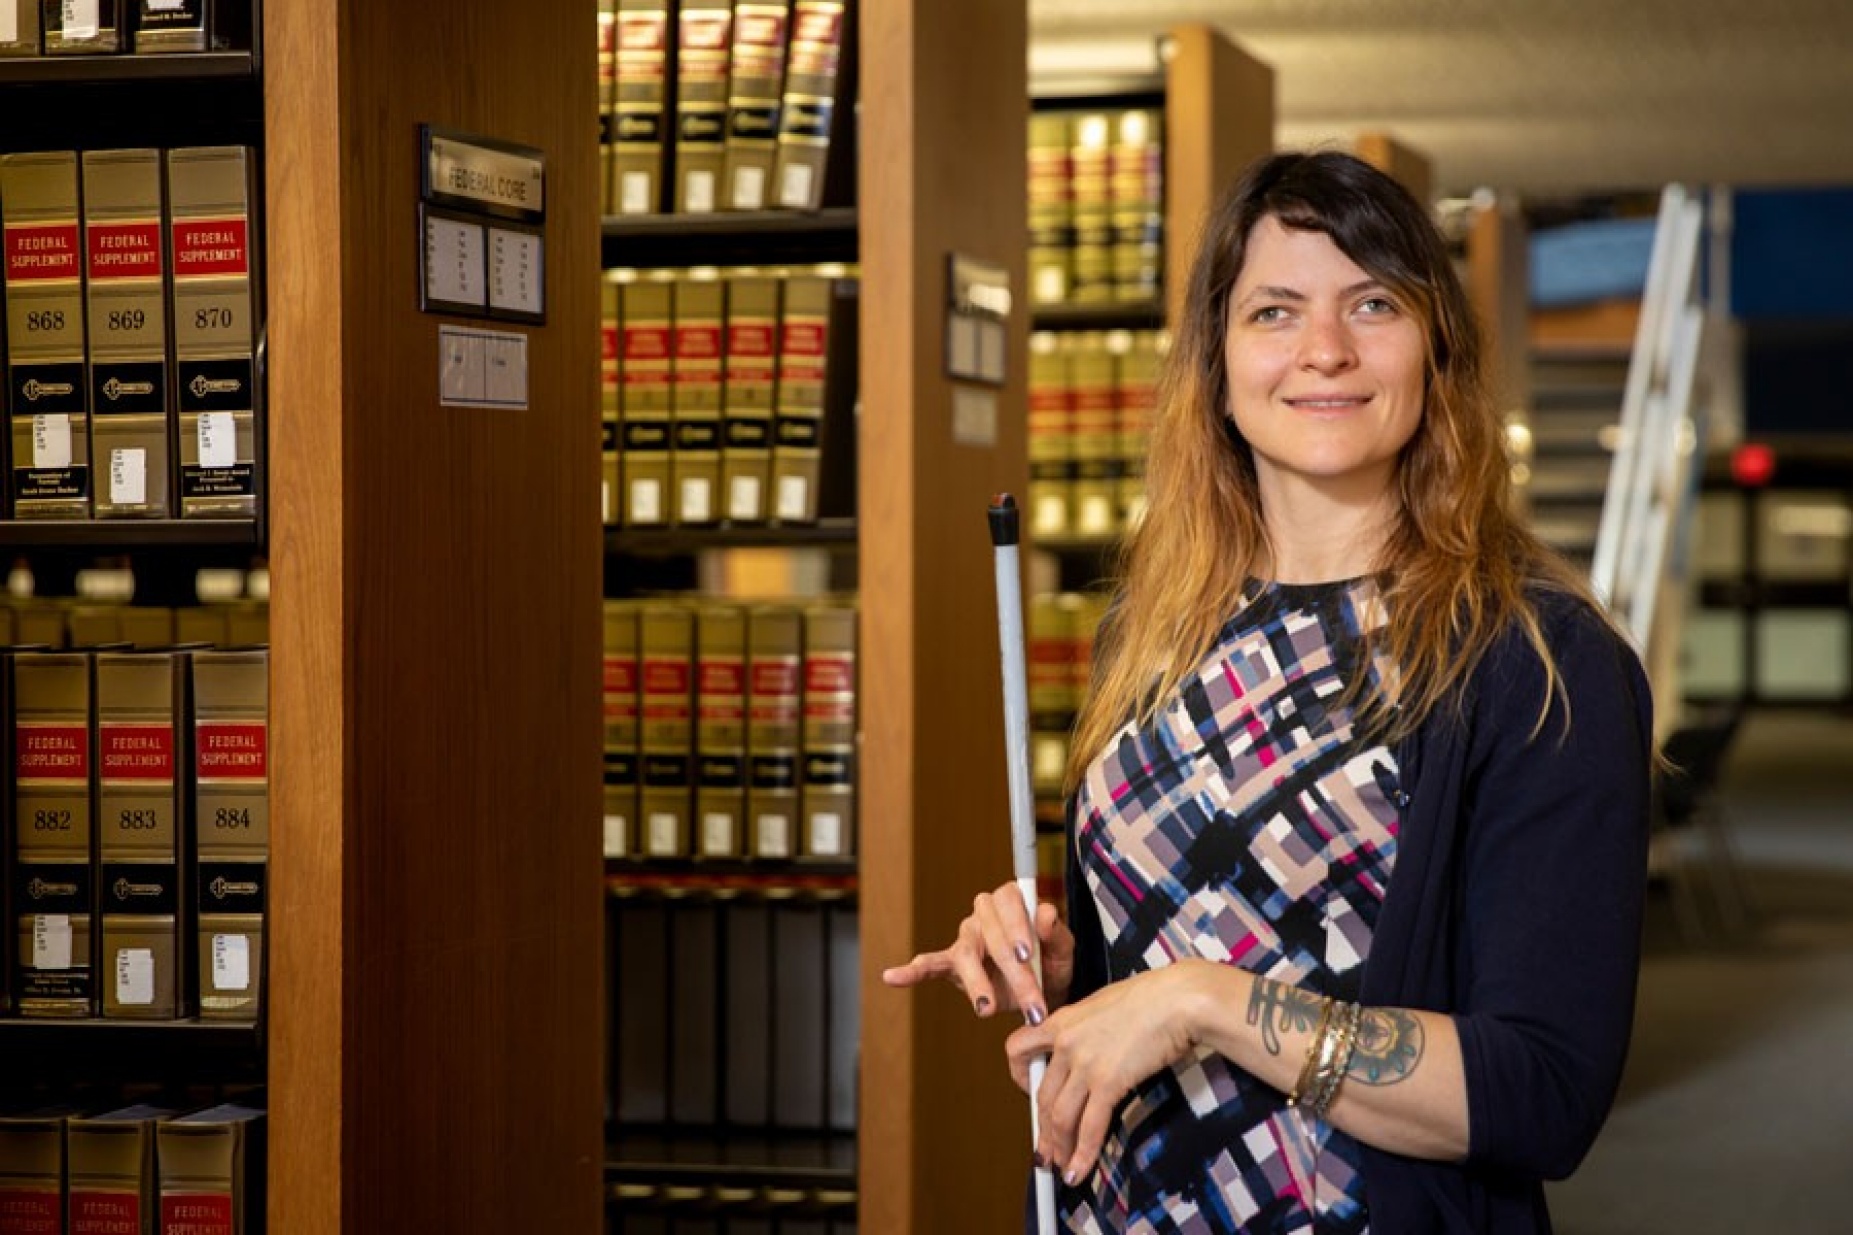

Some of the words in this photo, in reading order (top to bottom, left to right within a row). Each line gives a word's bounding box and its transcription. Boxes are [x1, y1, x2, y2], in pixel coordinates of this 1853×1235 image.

[449, 166, 496, 196] FEDERAL
[497, 177, 526, 202] CORE
[18, 236, 68, 250] FEDERAL
[100, 234, 149, 248] FEDERAL
[186, 231, 236, 245] FEDERAL
[11, 253, 73, 268] SUPPLEMENT
[94, 251, 155, 266] SUPPLEMENT
[180, 248, 242, 263] SUPPLEMENT
[27, 310, 65, 331] 868
[108, 309, 145, 330] 869
[195, 308, 232, 329] 870
[28, 737, 77, 750] FEDERAL
[113, 737, 162, 750] FEDERAL
[209, 735, 256, 748] FEDERAL
[20, 753, 81, 767] SUPPLEMENT
[105, 753, 167, 767] SUPPLEMENT
[201, 752, 262, 766] SUPPLEMENT
[34, 809, 71, 831] 882
[119, 809, 156, 830] 883
[215, 807, 250, 829] 884
[83, 1202, 130, 1216] FEDERAL
[174, 1205, 222, 1219] FEDERAL
